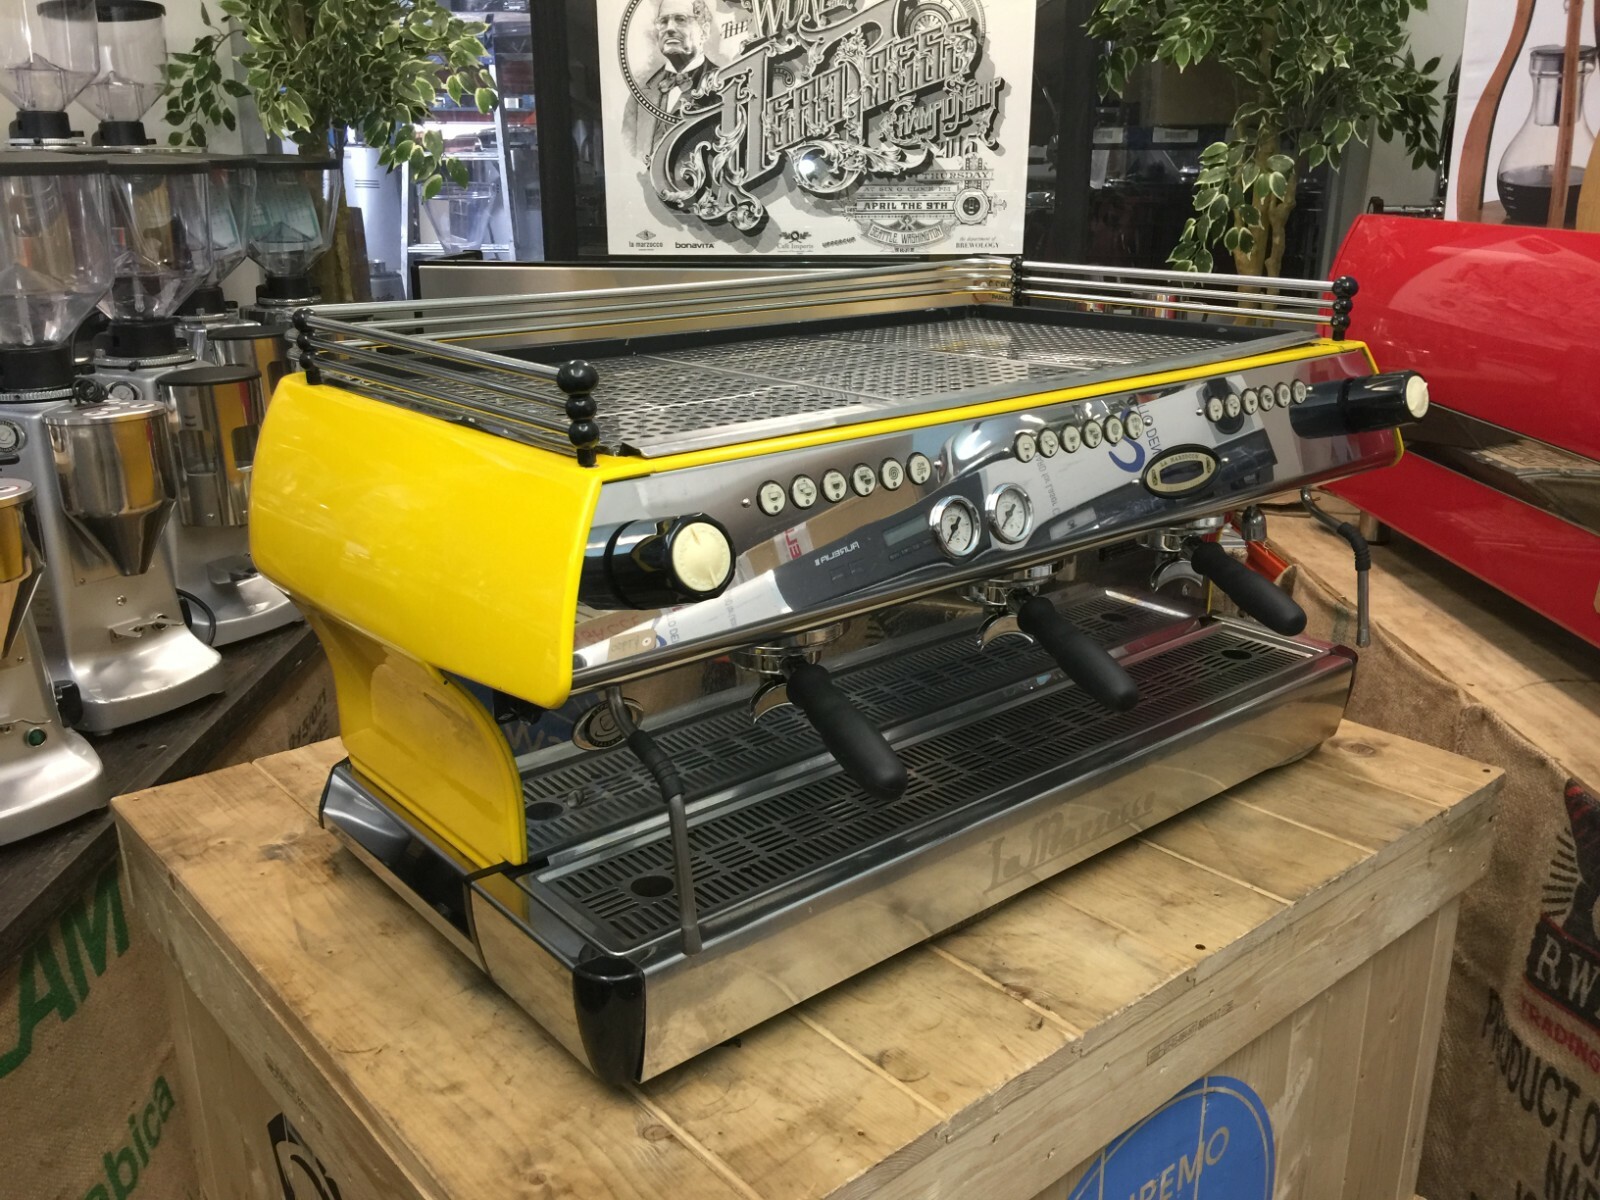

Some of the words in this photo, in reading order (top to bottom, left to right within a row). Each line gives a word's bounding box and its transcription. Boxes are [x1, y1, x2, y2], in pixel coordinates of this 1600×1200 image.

[922, 172, 989, 180] THURSDAY
[864, 202, 897, 210] APRIL
[901, 202, 922, 210] THE
[926, 202, 948, 210] 9TH
[901, 225, 943, 244] WASHINGTON
[1481, 985, 1582, 1141] PRODUCT
